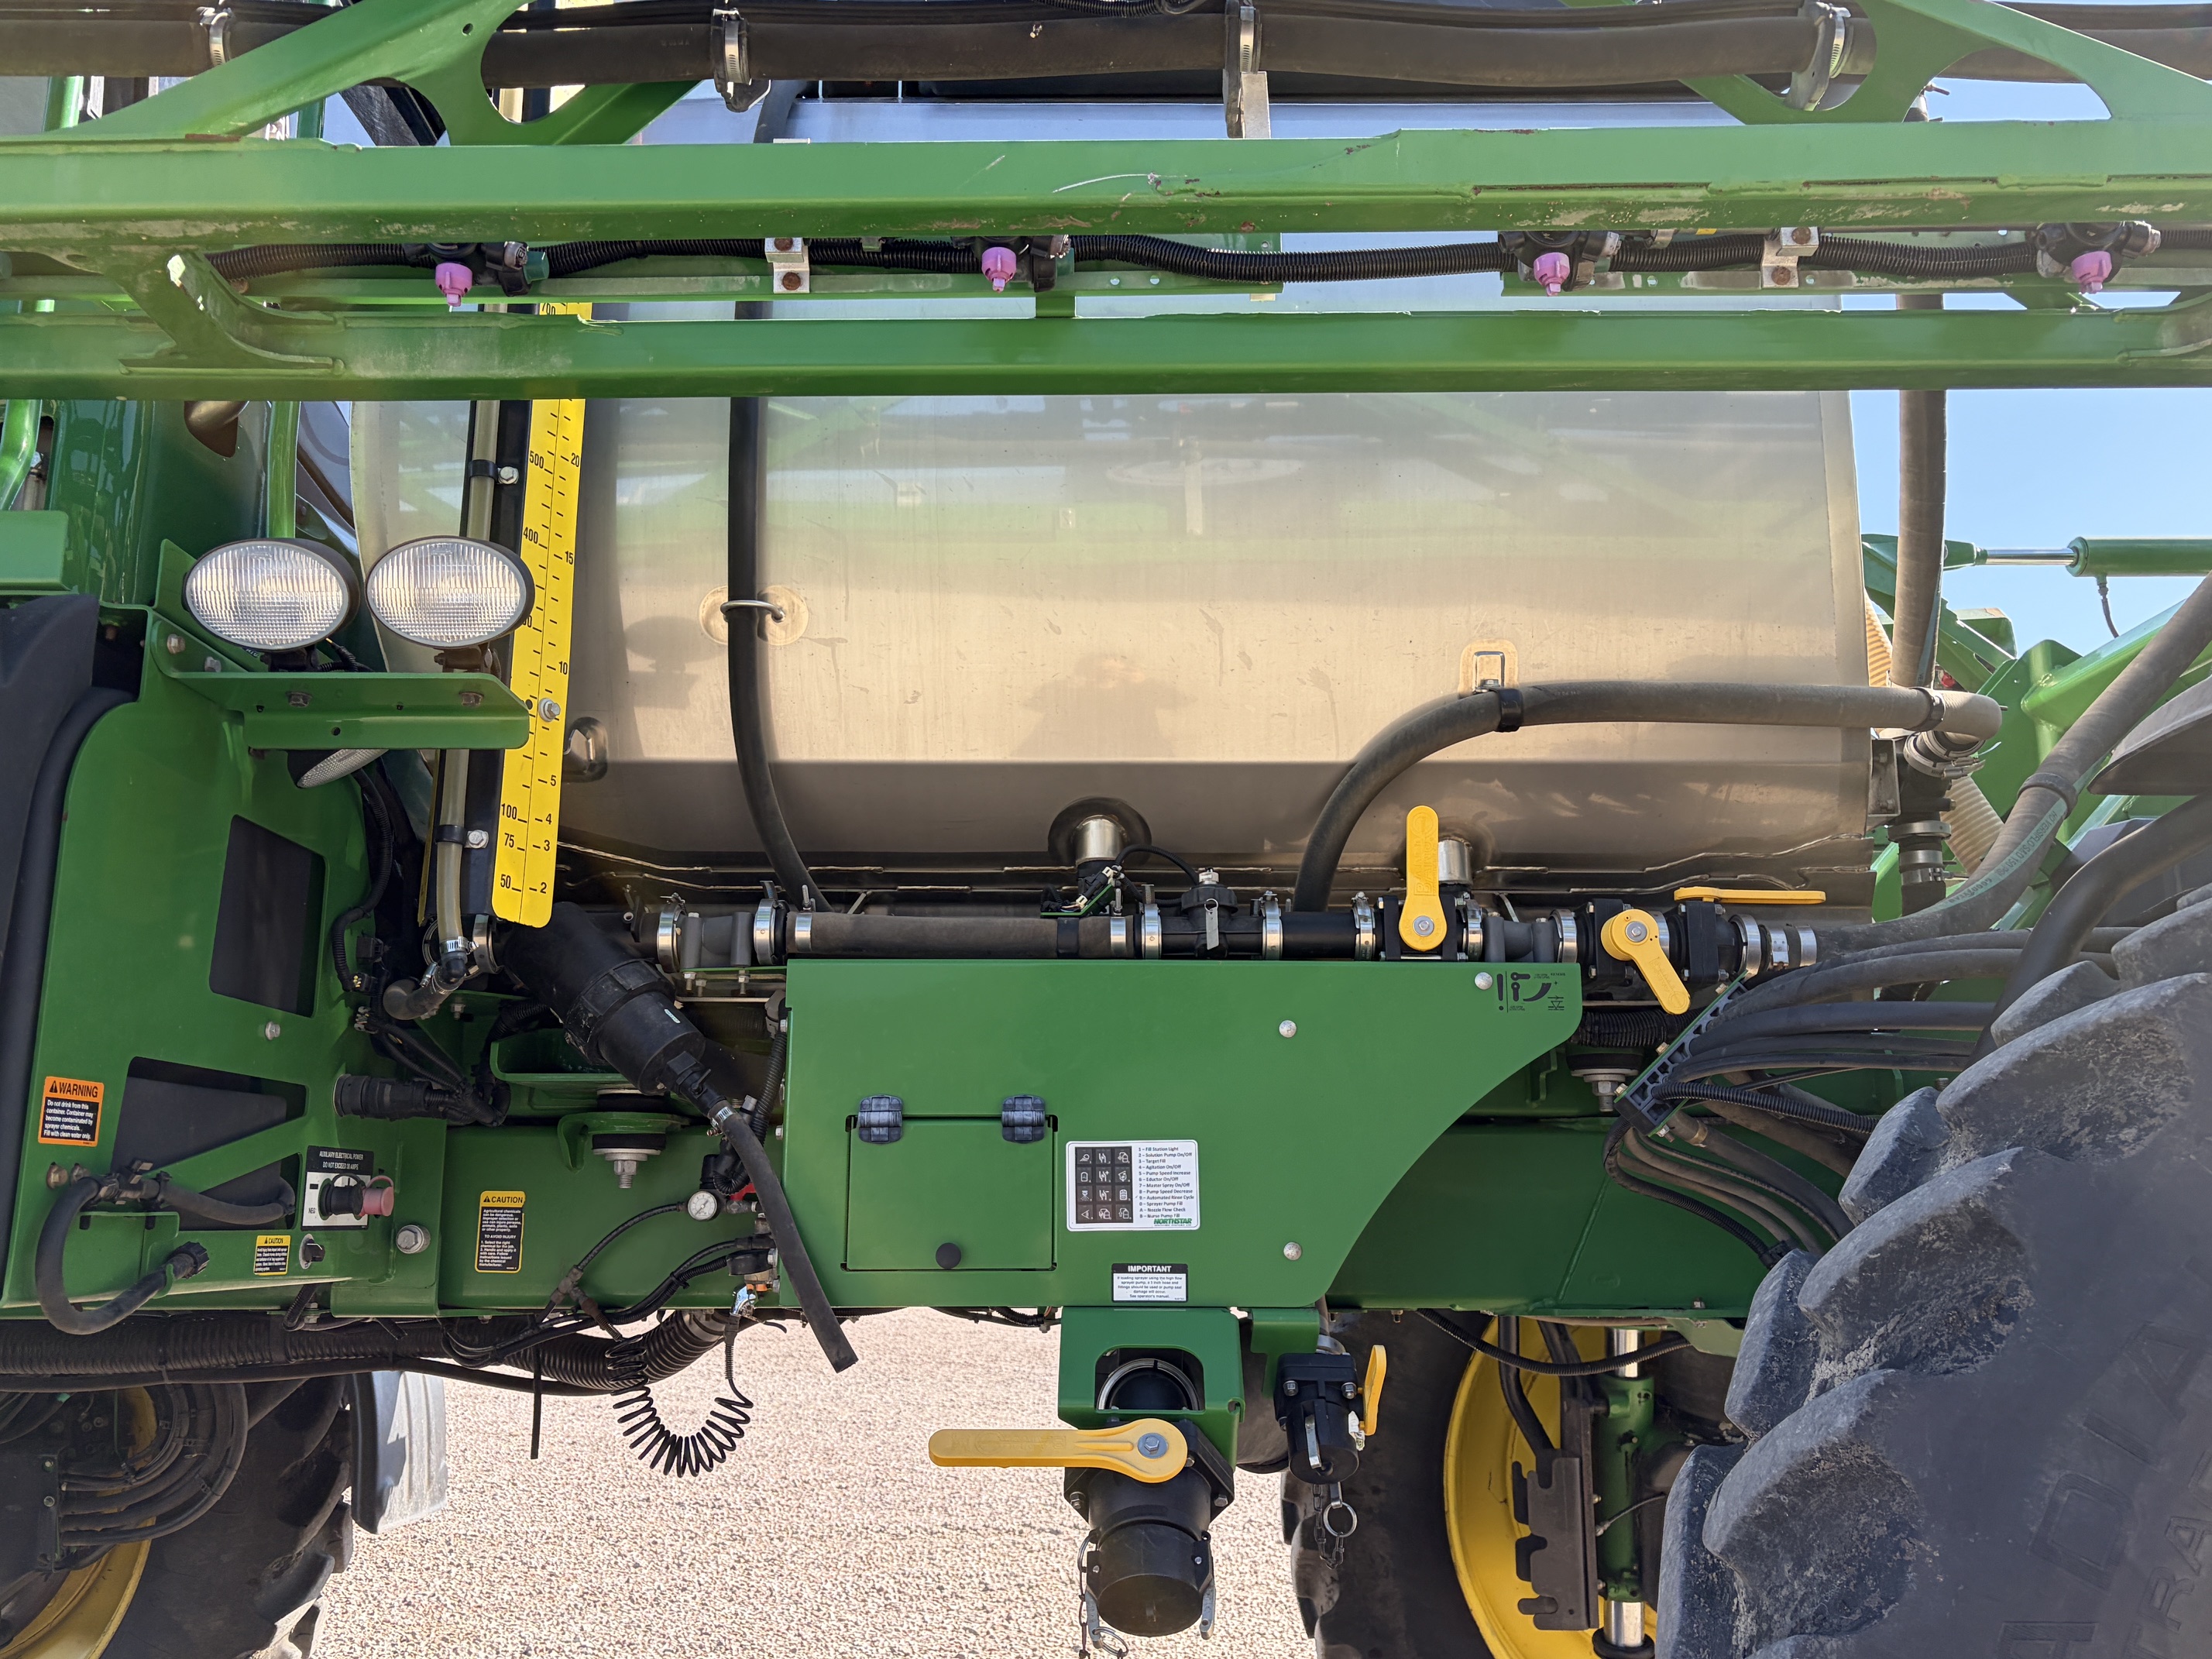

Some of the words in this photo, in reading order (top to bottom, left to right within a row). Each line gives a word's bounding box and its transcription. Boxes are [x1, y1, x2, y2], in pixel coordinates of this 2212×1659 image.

[529, 450, 544, 469] 500
[571, 452, 580, 467] 20
[523, 527, 538, 544] 400
[565, 551, 574, 565] 15
[559, 661, 568, 675] 10
[550, 775, 556, 787] 5
[501, 803, 517, 820] 100
[2050, 811, 2058, 823] HD
[546, 813, 552, 825] 4
[504, 832, 515, 848] 75
[2028, 821, 2052, 847] VERSIFLO
[544, 840, 550, 851] 3
[2018, 846, 2030, 859] S&D
[2007, 857, 2017, 868] 150
[500, 874, 511, 889] 50
[540, 882, 547, 894] 2
[1948, 878, 1993, 903] GOODYEAR
[59, 1082, 98, 1098] WARNING
